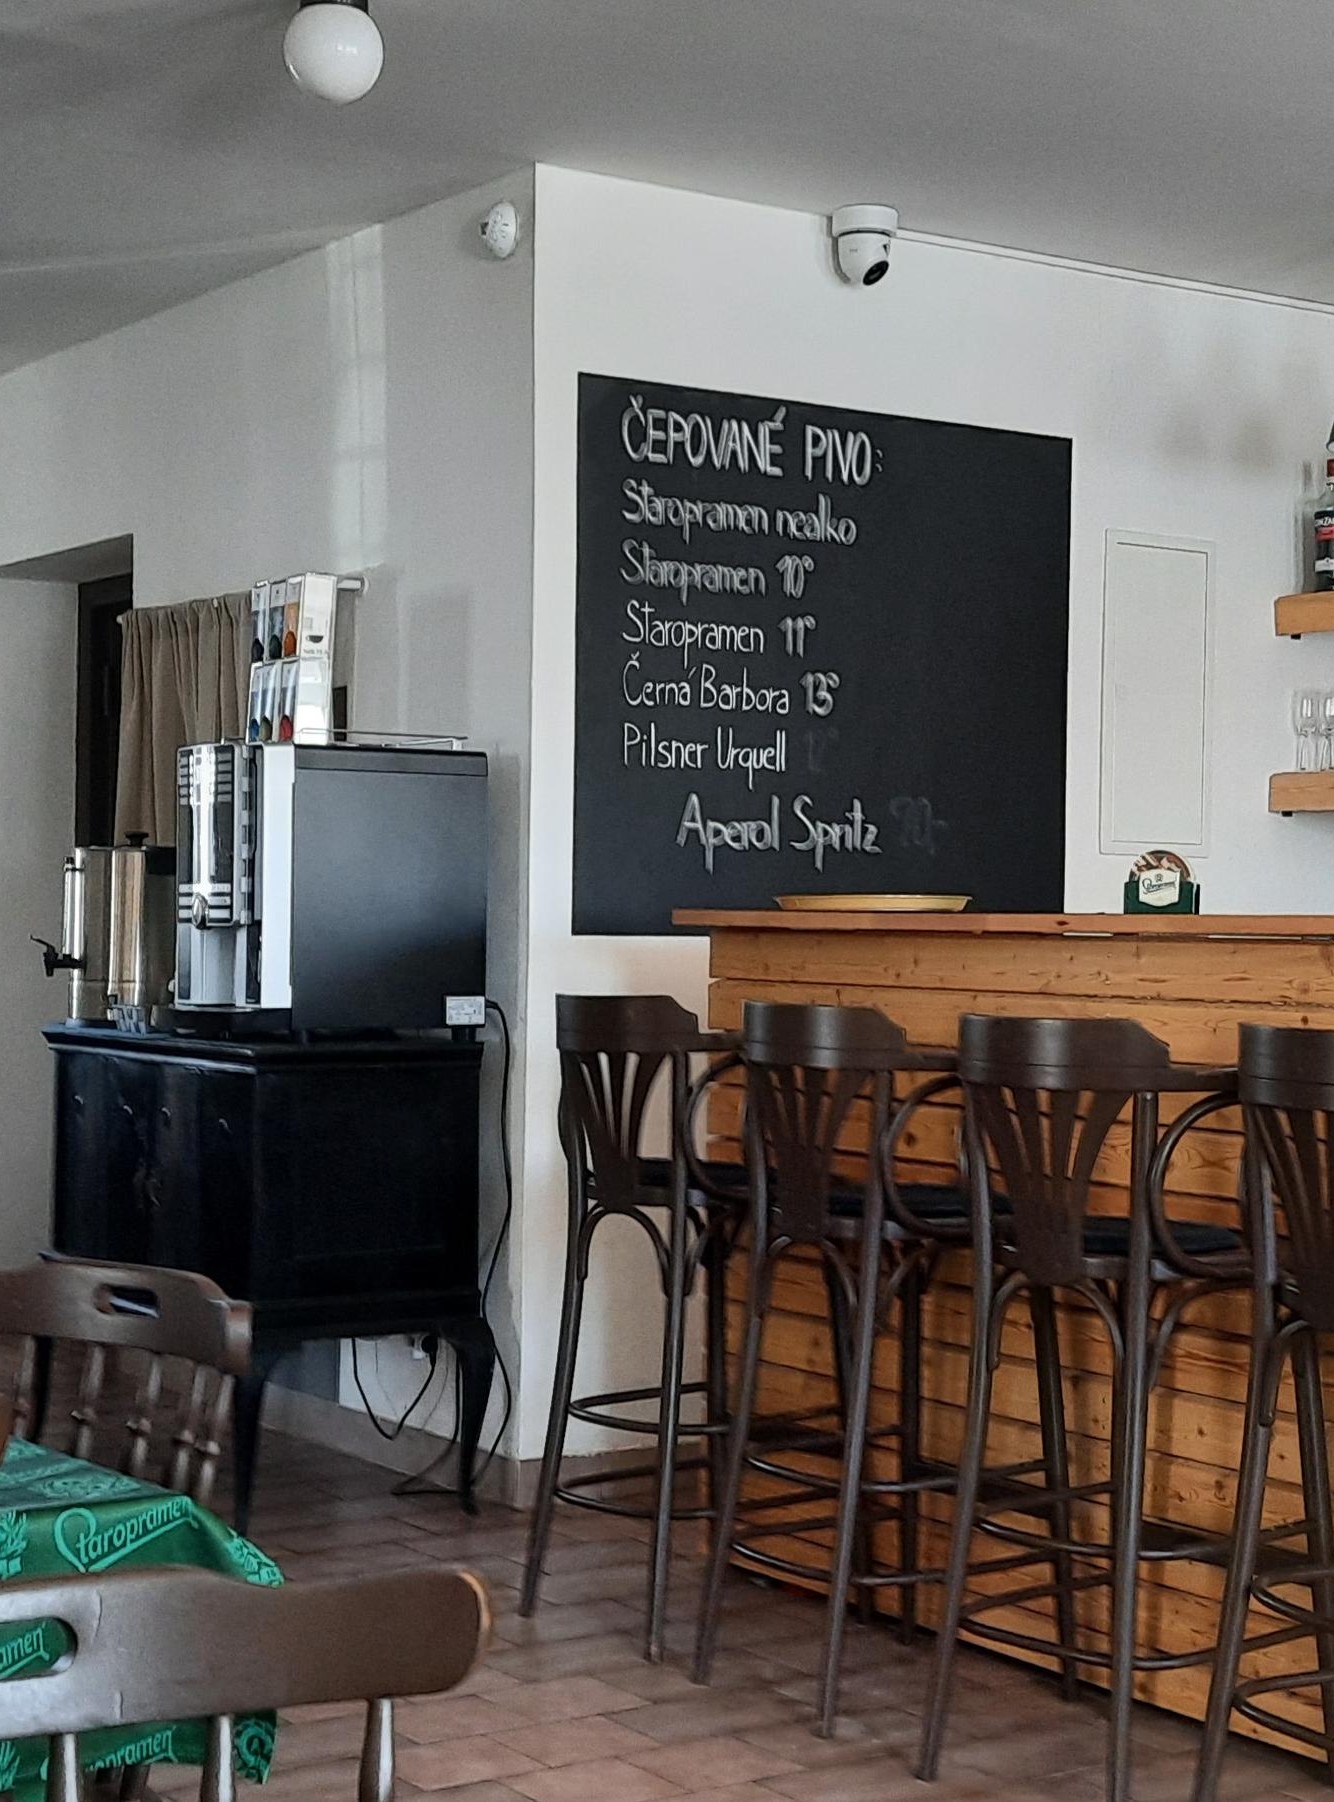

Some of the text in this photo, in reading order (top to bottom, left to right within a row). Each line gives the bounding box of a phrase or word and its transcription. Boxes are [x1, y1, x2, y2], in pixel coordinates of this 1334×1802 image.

[622, 394, 787, 477] ČEPOVANÉ
[622, 478, 857, 545] Staropramen nealko
[620, 538, 766, 605] Staropramen
[623, 599, 765, 669] Staropramen
[623, 652, 696, 708] Černá
[700, 664, 791, 715] Barbora
[624, 722, 709, 769] Pilsner
[717, 726, 787, 790] Urquell
[676, 792, 781, 875] Aperol
[789, 794, 883, 873] Spritz
